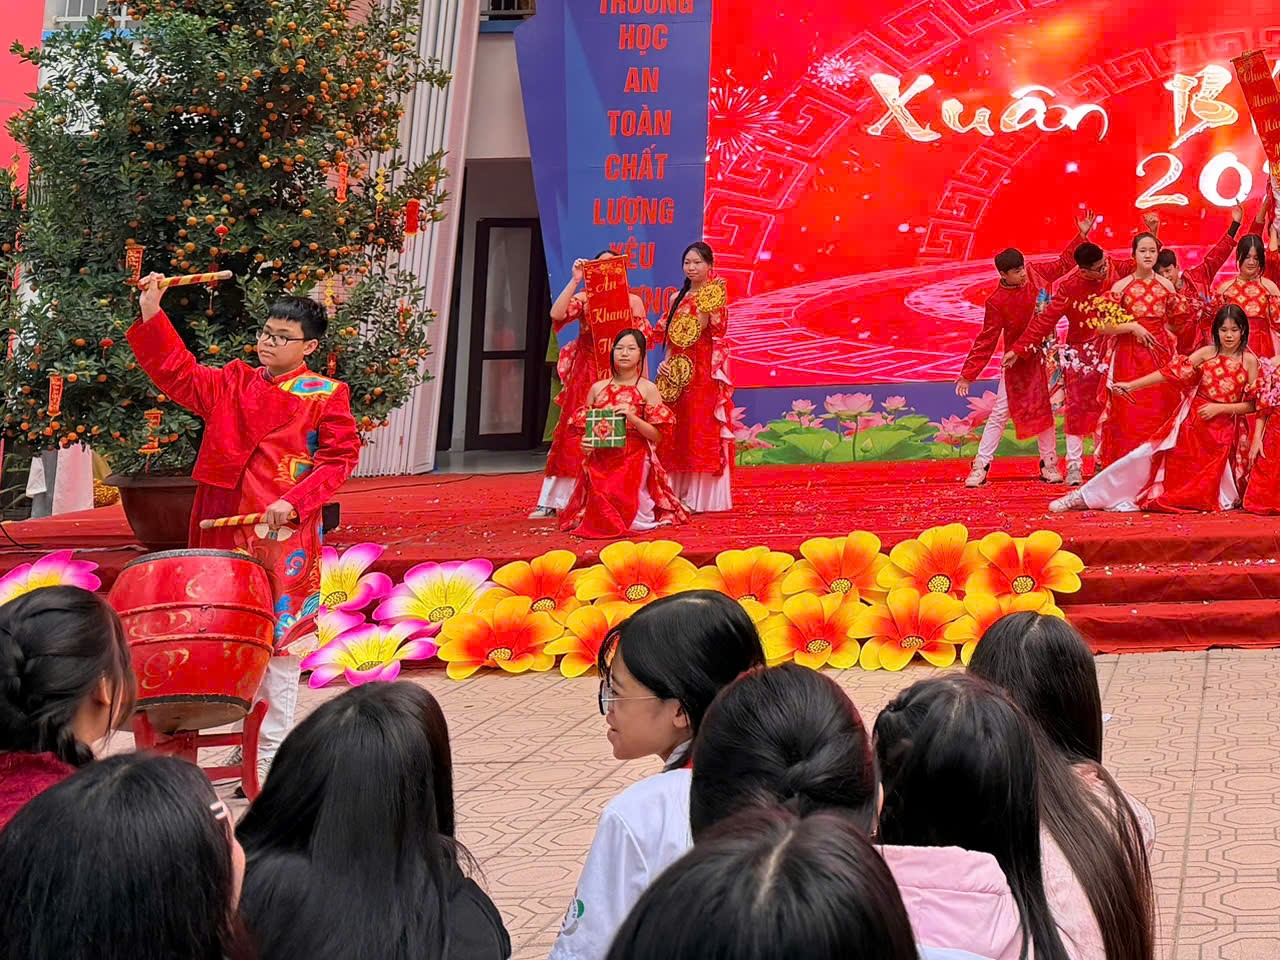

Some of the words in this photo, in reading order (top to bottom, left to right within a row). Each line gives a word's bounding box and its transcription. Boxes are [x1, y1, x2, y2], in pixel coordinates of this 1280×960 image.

[618, 23, 668, 56] HỌC
[623, 67, 659, 93] AN
[607, 104, 672, 137] TOÀN
[866, 73, 1109, 142] Xuân
[604, 143, 668, 181] CHẤT
[592, 197, 675, 231] LƯỢNG
[595, 275, 617, 294] An
[591, 306, 630, 325] Khang
